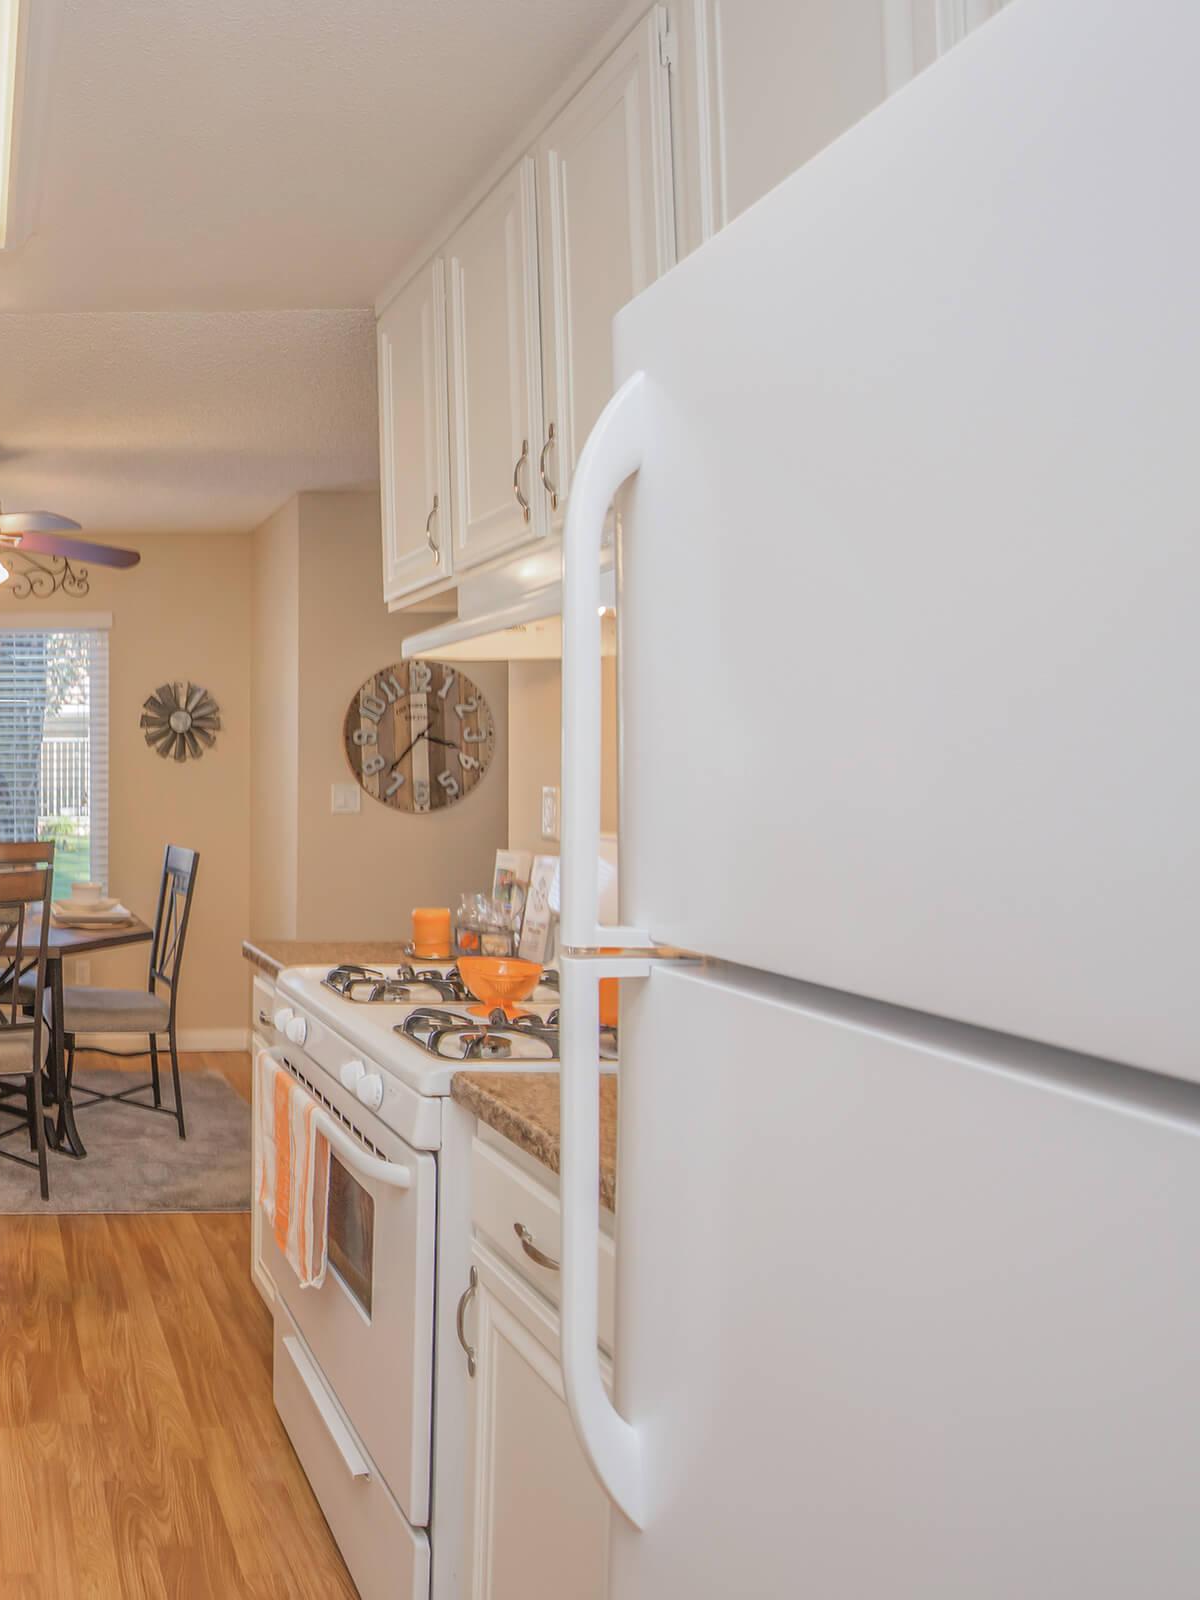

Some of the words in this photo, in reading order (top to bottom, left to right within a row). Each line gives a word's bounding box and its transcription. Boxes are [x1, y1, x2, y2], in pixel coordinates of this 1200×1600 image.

[380, 676, 405, 703] 11
[410, 666, 432, 693] 12
[437, 676, 454, 699] 1
[359, 696, 386, 724] 10
[454, 696, 478, 720] 2
[353, 728, 377, 746] 9
[463, 727, 486, 743] 3
[362, 755, 385, 776] 8
[458, 752, 480, 771] 4
[385, 771, 405, 796] 7
[415, 780, 429, 804] 6
[437, 768, 459, 796] 5
